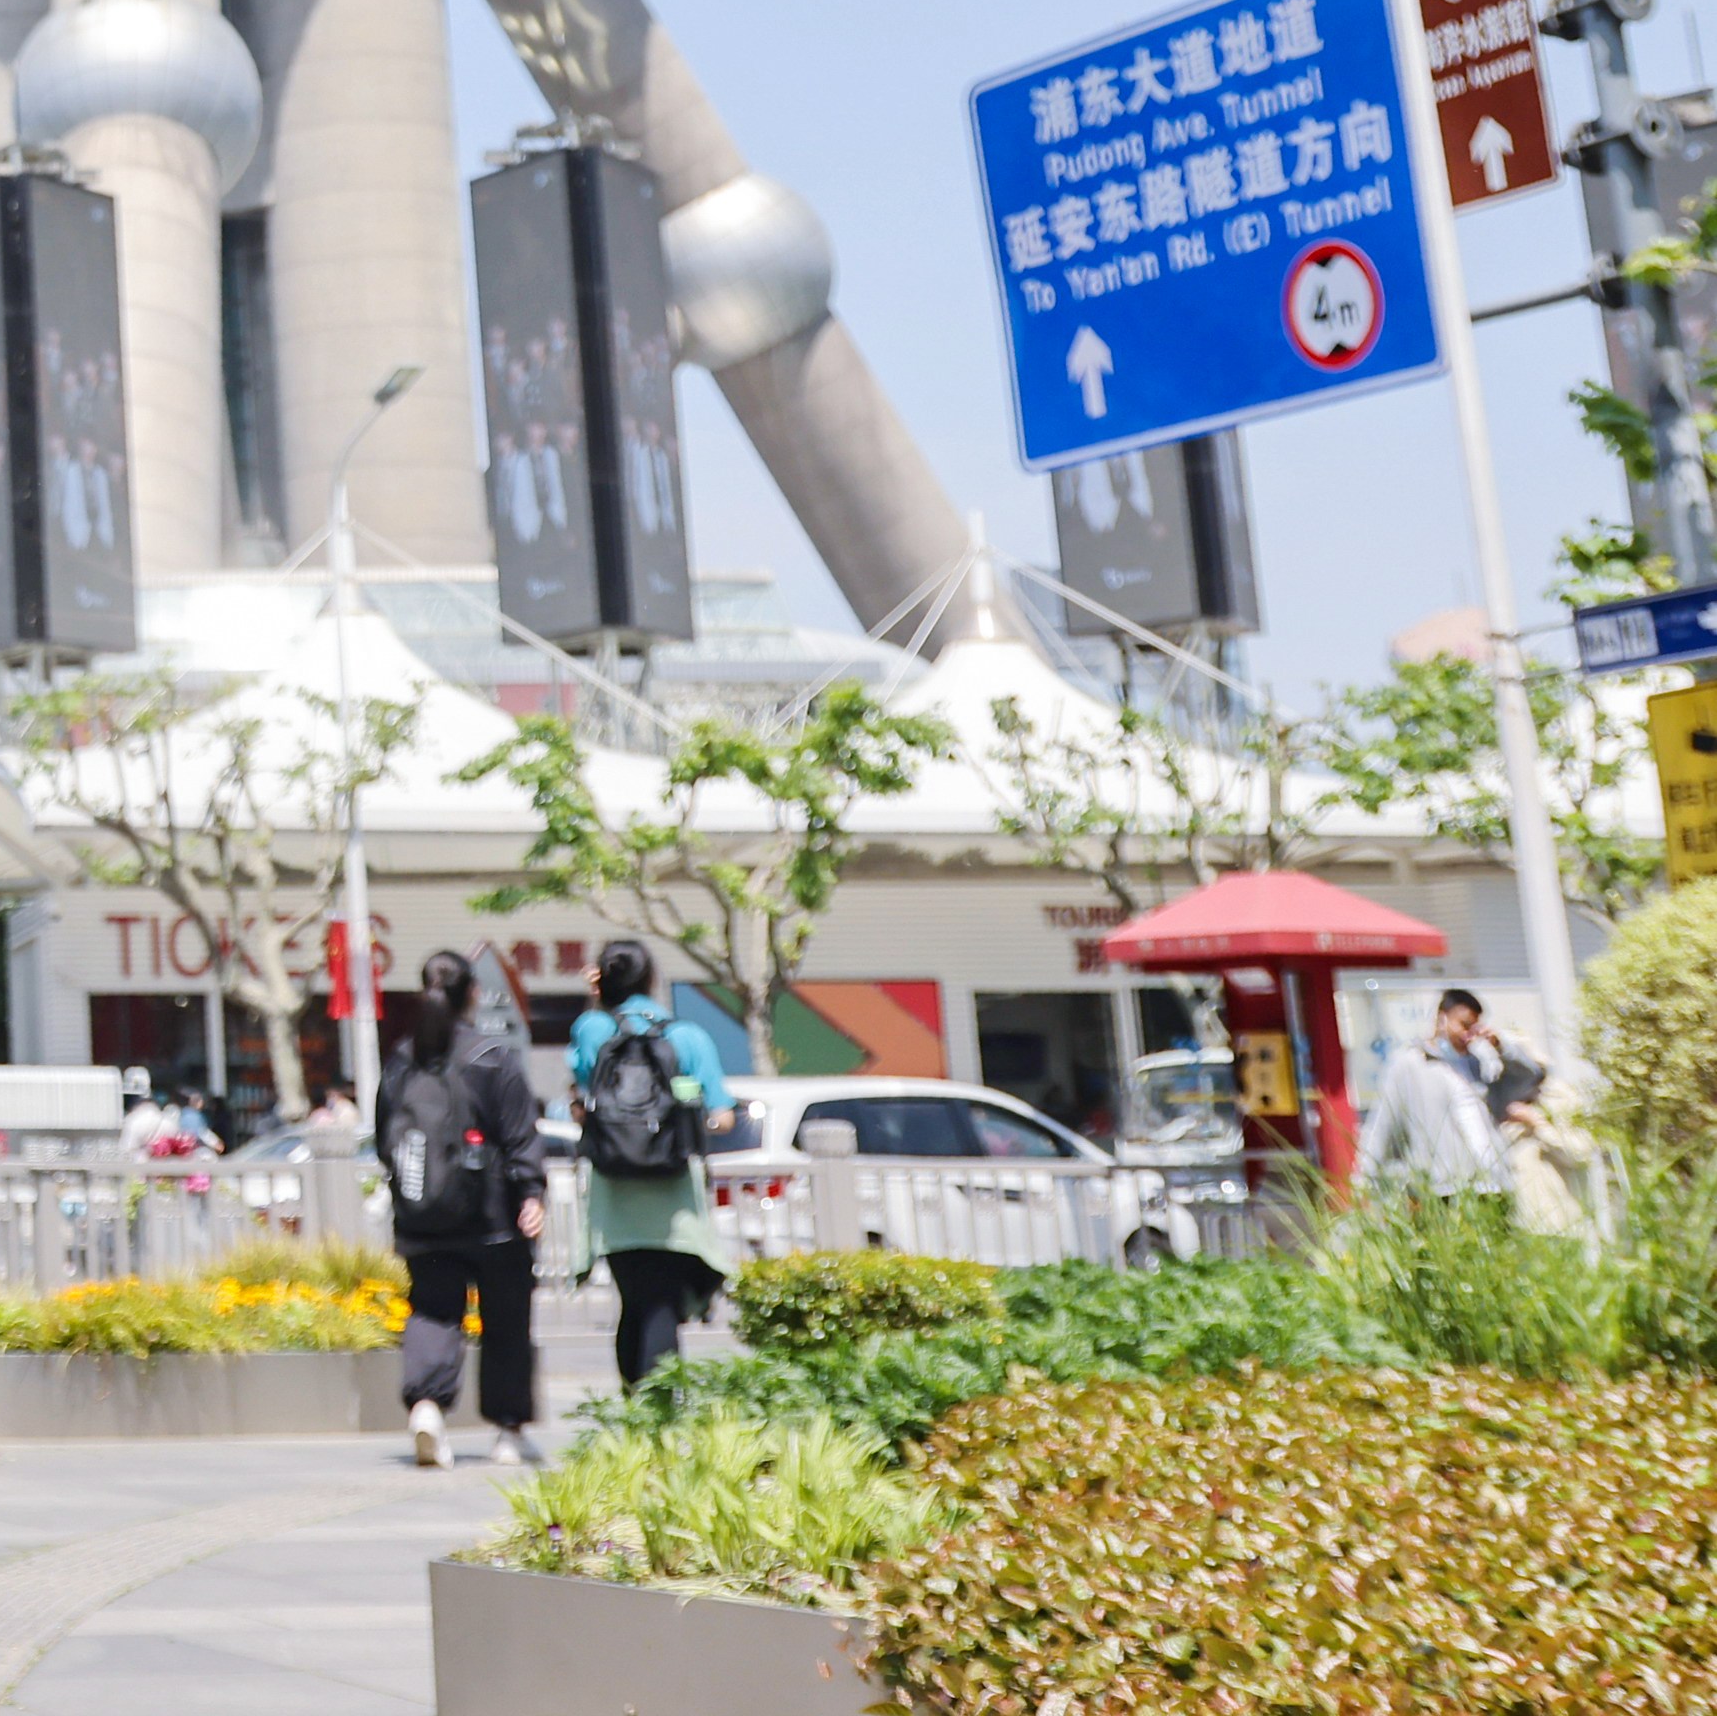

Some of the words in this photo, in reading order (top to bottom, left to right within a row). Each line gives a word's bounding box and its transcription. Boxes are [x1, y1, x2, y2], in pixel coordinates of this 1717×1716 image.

[1002, 99, 1393, 273] 延安东路隧道方向
[1043, 131, 1147, 188] Pudong
[1152, 112, 1215, 154] Ave.
[1218, 66, 1324, 128] Tunnel
[1021, 277, 1057, 314] To
[1167, 229, 1215, 273] Rd.
[1223, 212, 1271, 256] (E)
[1279, 175, 1393, 238] Tunnel
